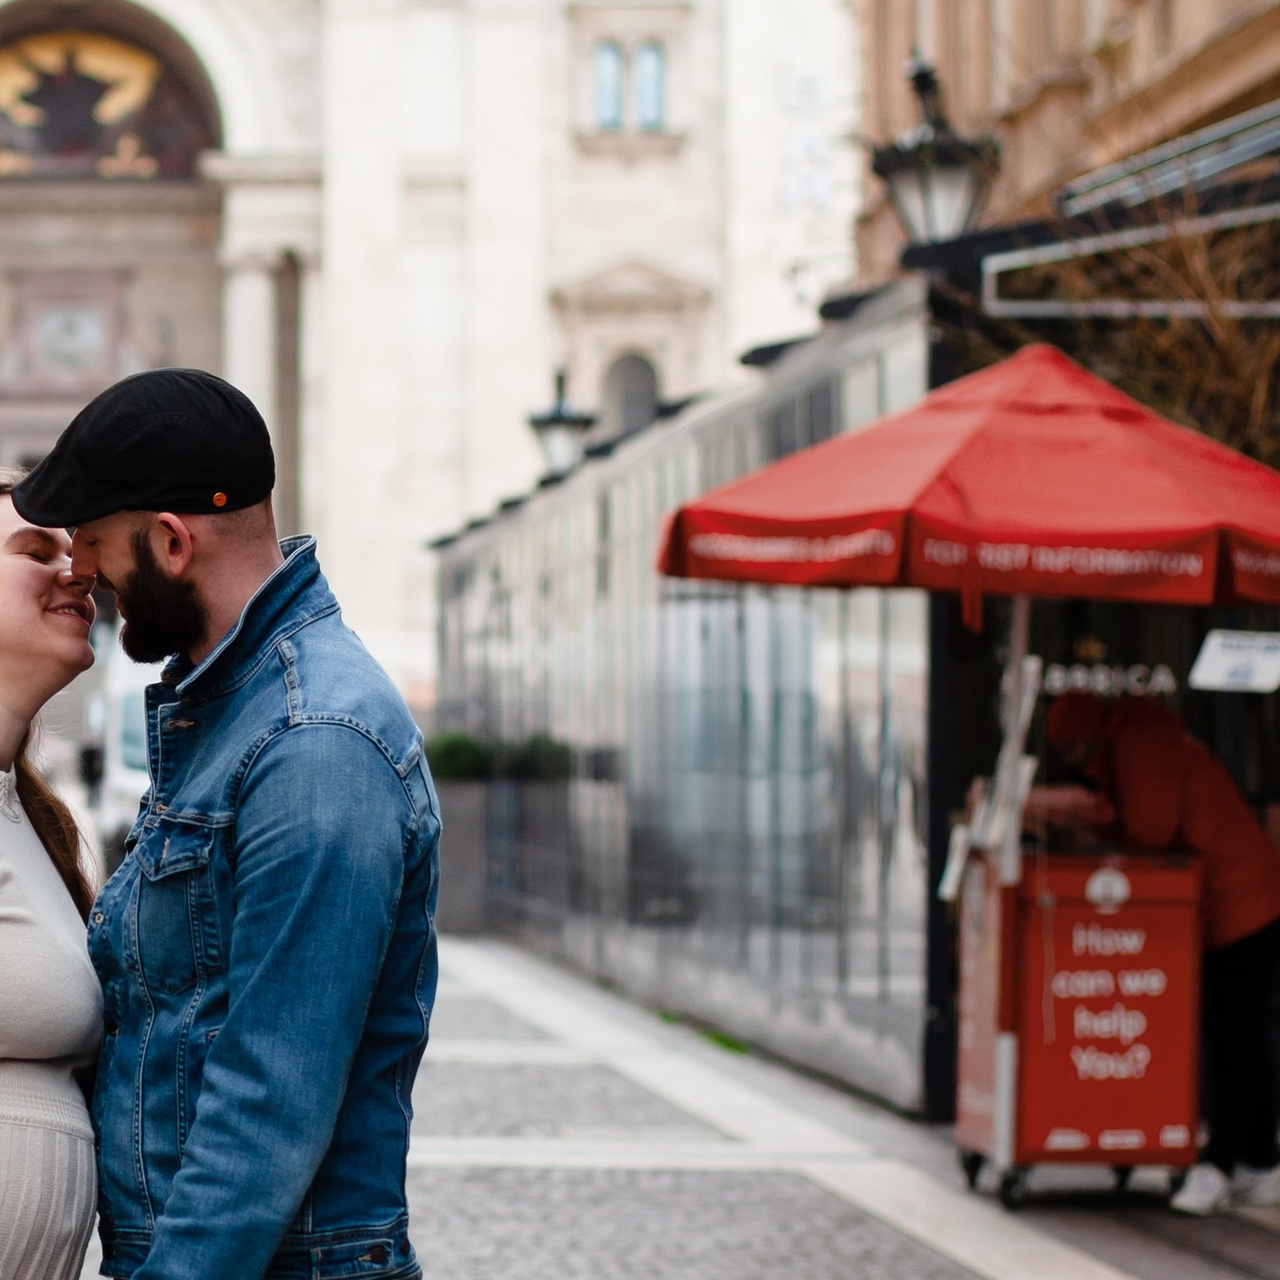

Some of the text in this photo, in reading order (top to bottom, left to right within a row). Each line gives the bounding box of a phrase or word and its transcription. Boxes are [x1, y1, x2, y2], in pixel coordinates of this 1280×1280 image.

[1031, 545, 1203, 577] INFORMATION
[1072, 921, 1147, 956] How
[1052, 967, 1168, 999] can we
[1073, 1002, 1148, 1046] help
[1071, 1043, 1152, 1080] You?
